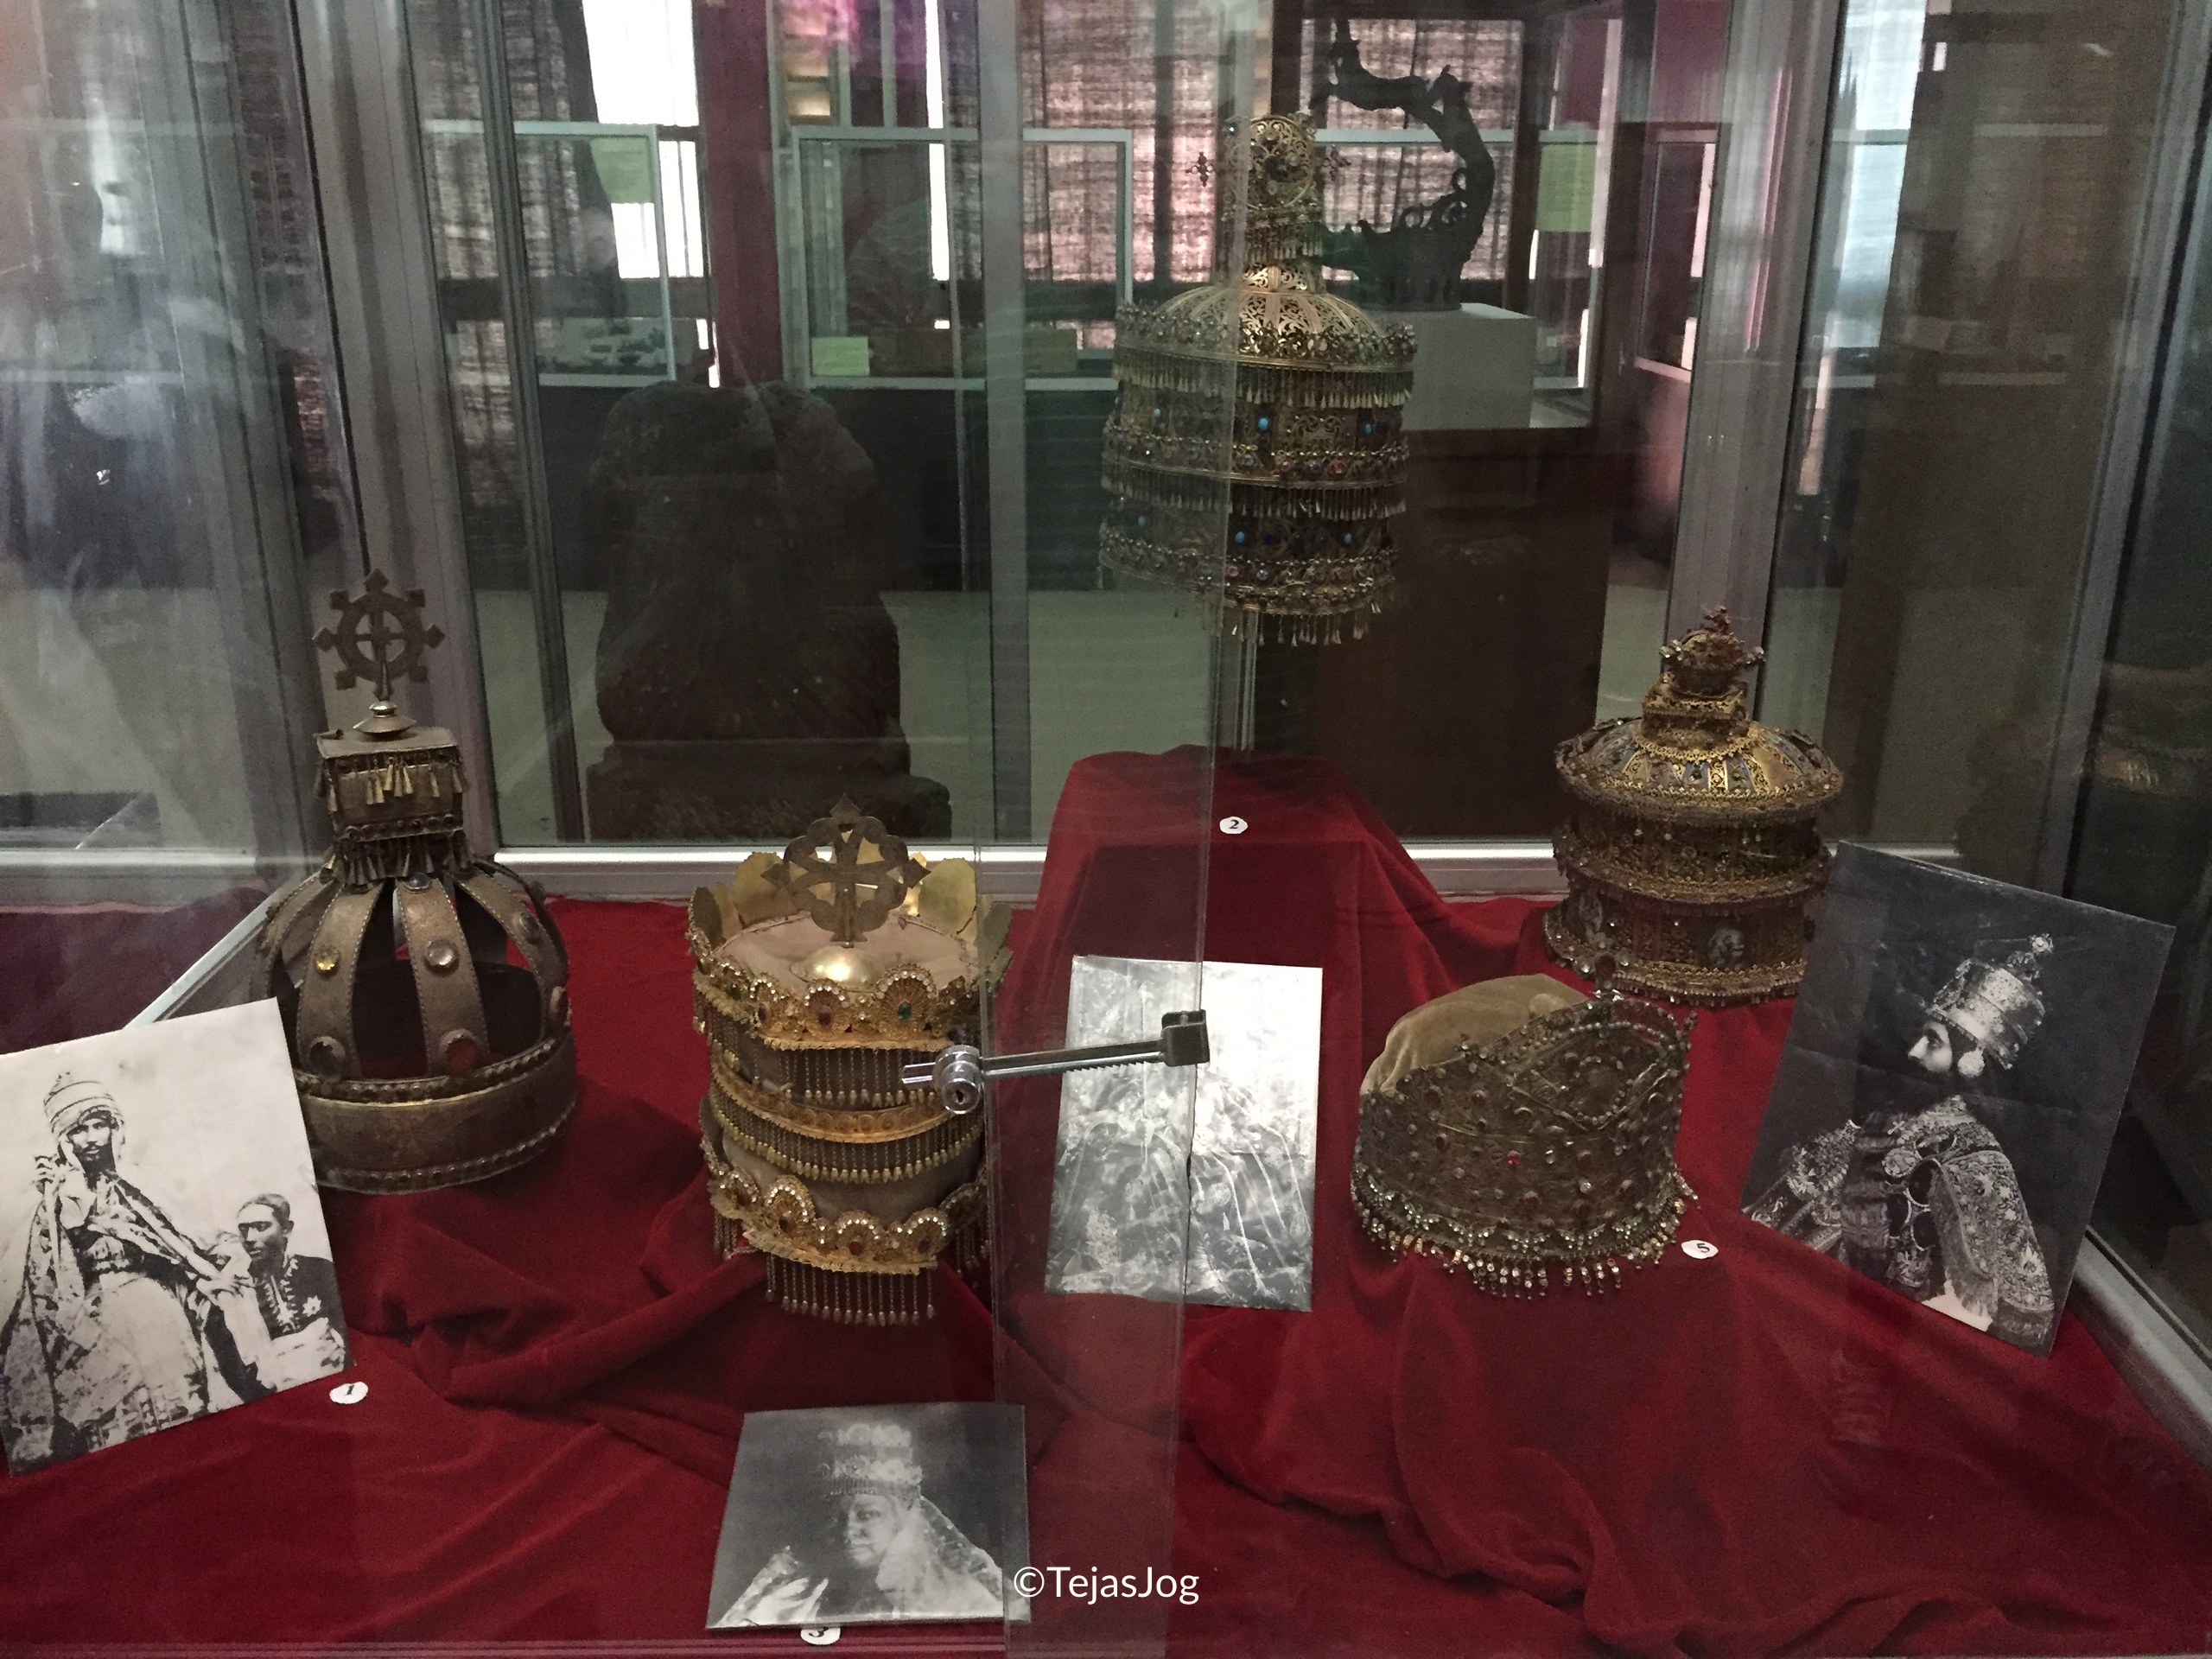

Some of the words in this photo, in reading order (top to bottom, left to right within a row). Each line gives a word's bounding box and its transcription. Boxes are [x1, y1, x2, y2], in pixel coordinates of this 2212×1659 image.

[1229, 819, 1240, 830] 2
[1696, 1243, 1710, 1254] 5
[346, 1384, 355, 1395] 1
